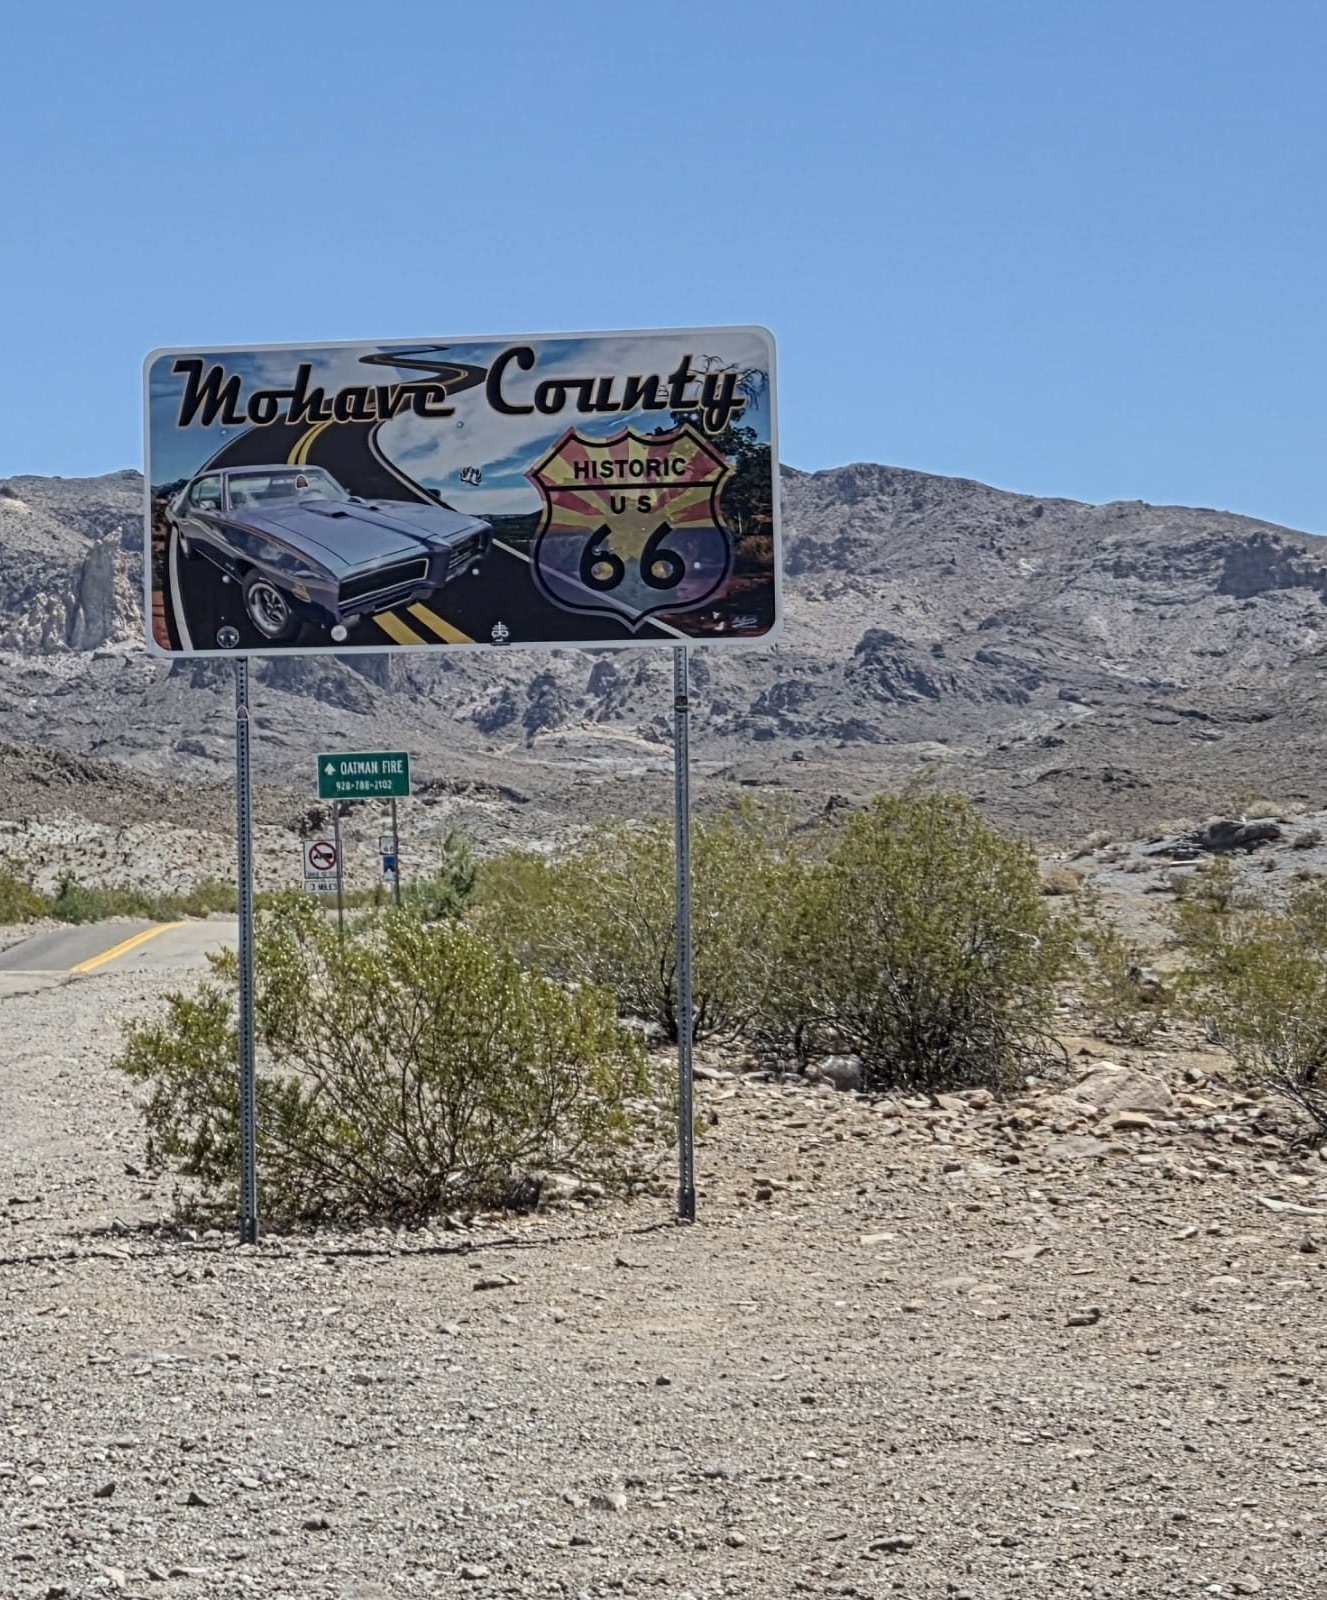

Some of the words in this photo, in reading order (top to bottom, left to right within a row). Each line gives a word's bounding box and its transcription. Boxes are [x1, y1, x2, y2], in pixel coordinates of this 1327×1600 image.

[172, 357, 456, 428] Mohave
[485, 345, 747, 435] County
[573, 457, 687, 480] HISTORIC
[579, 521, 686, 592] 66
[340, 760, 378, 775] OATMAN
[382, 759, 404, 774] FIRE
